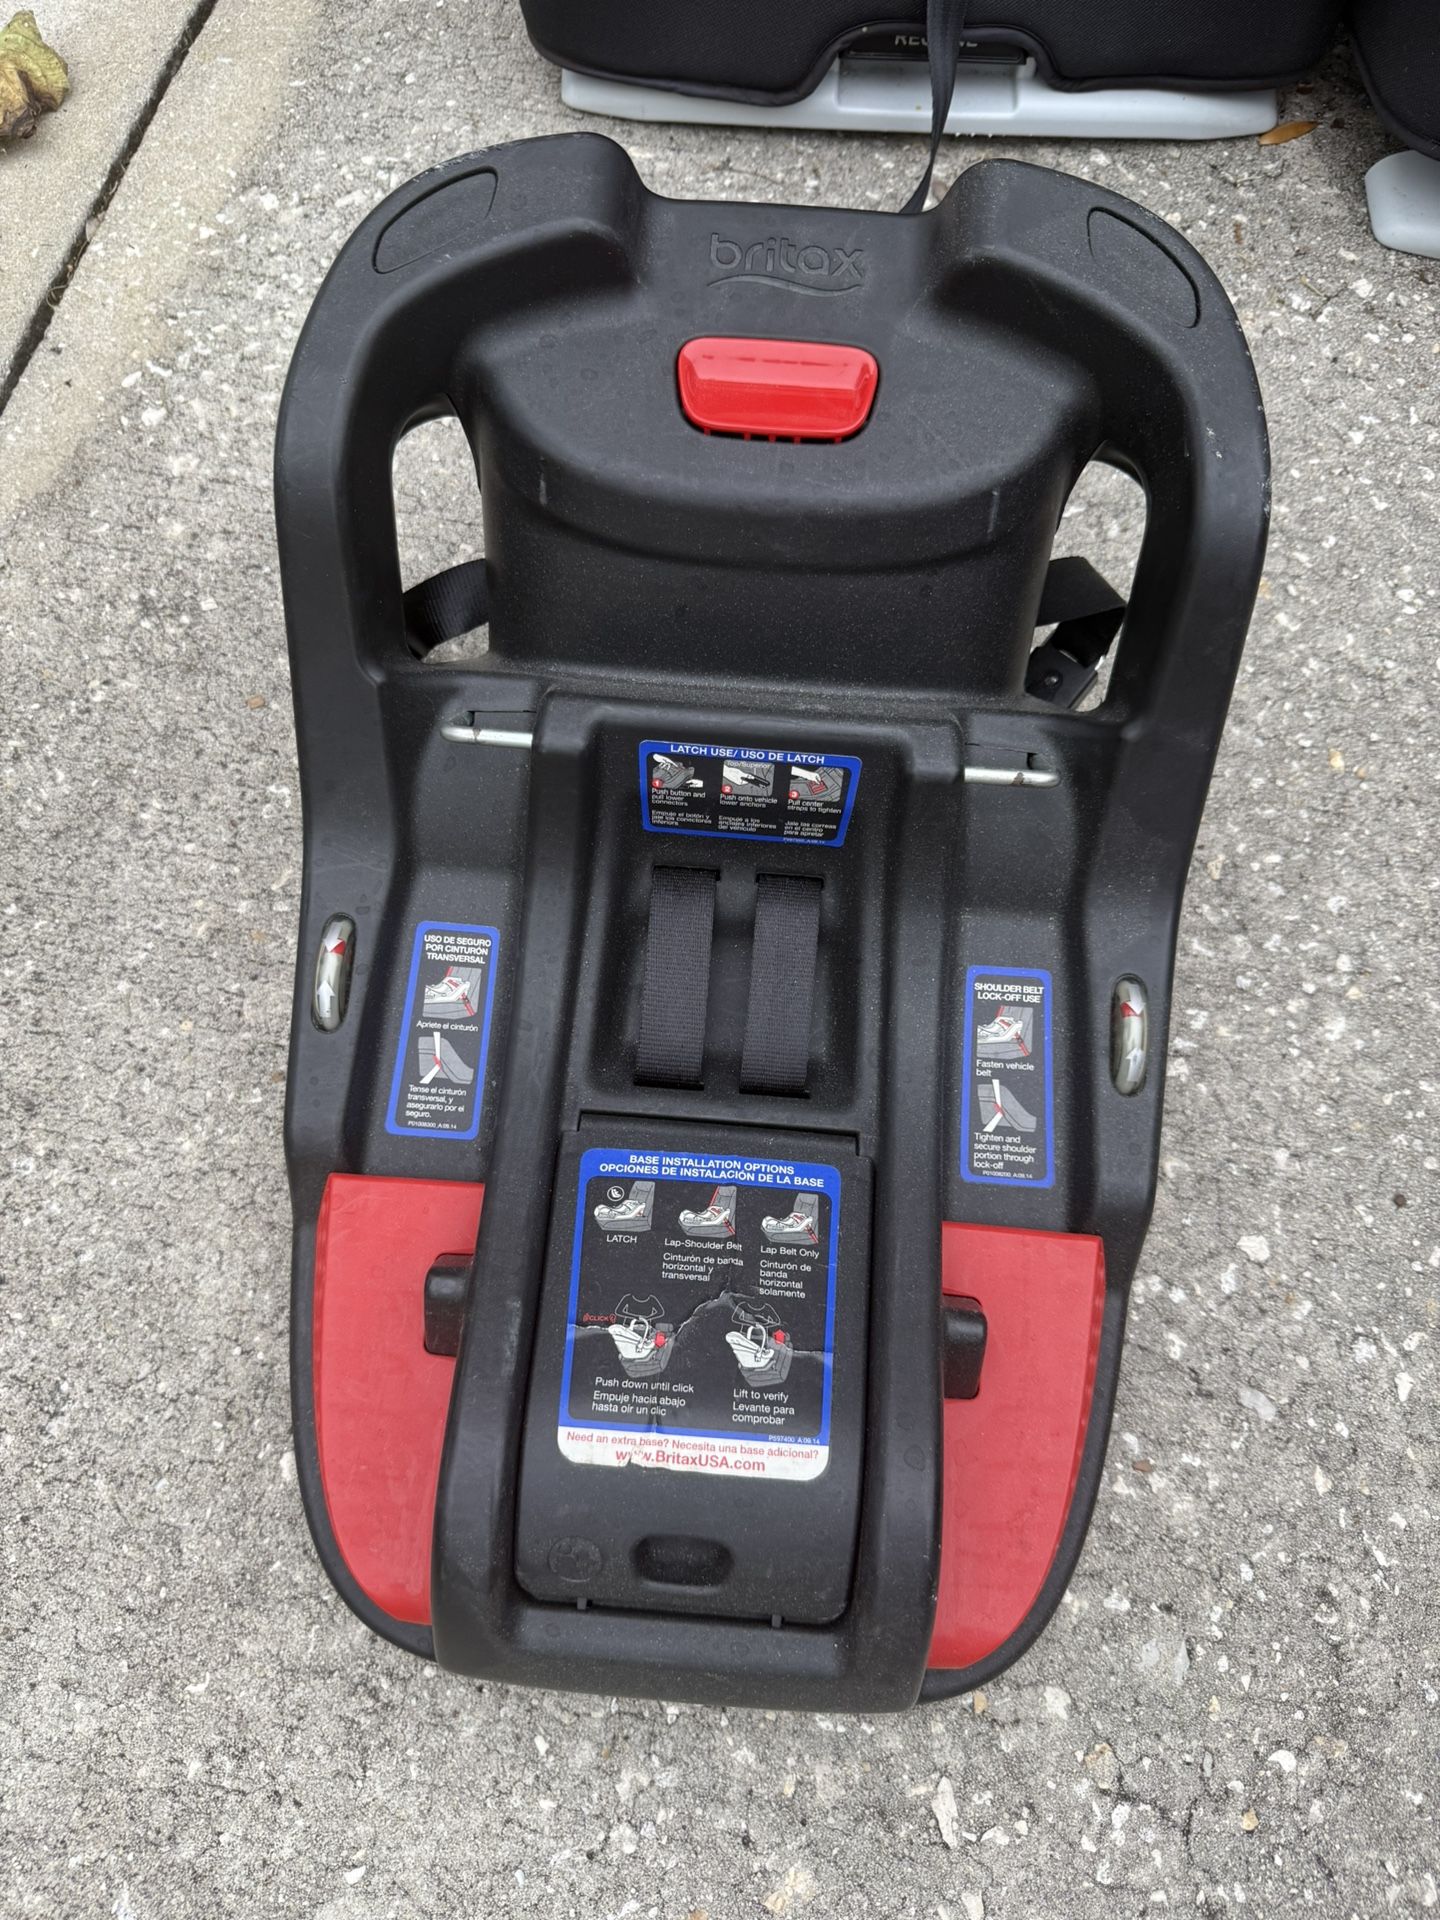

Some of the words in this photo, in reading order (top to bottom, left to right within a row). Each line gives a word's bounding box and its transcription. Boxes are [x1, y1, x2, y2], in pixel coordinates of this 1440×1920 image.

[895, 35, 978, 47] RECE
[710, 232, 864, 279] britax
[670, 744, 708, 755] LATCH
[710, 749, 738, 758] USE/
[741, 750, 765, 760] USO
[768, 752, 784, 761] DE
[787, 753, 825, 764] LATCH
[739, 800, 767, 808] anchors
[754, 796, 778, 804] vehicle
[818, 807, 842, 815] tighten
[424, 934, 442, 943] USO
[443, 936, 455, 944] DE
[456, 938, 492, 947] SEGURO
[425, 943, 444, 952] POR
[444, 945, 488, 956] CINTURÓN
[426, 952, 486, 965] TRANSVERSAL
[974, 982, 1022, 993] SHOULDER
[1023, 985, 1045, 994] BELT
[977, 992, 1022, 1002] LOCK-OFF
[1022, 994, 1041, 1004] USE
[416, 1020, 441, 1029] Apriete
[442, 1022, 449, 1030] el
[450, 1023, 479, 1032] cinturón
[976, 1059, 1004, 1069] Fasten
[1005, 1061, 1035, 1071] vehicle
[976, 1068, 992, 1077] belt
[409, 1084, 430, 1094] Tense
[430, 1086, 437, 1094] el
[438, 1087, 467, 1096] cinturón
[407, 1093, 447, 1103] transversal,
[406, 1102, 443, 1111] asegurarlo
[443, 1105, 457, 1113] por
[457, 1105, 465, 1113] el
[405, 1110, 432, 1119] seguro.
[974, 1132, 1004, 1143] Tighten
[1005, 1135, 1021, 1143] and
[974, 1143, 1001, 1152] secure
[1002, 1144, 1037, 1154] shoulder
[629, 1154, 660, 1165] BASE
[662, 1157, 741, 1170] INSTALLATION
[743, 1162, 795, 1175] OPTIONS
[973, 1152, 1002, 1161] portion
[1003, 1153, 1034, 1165] through
[973, 1159, 1004, 1169] lock-off
[599, 1163, 659, 1175] OPCIONES
[661, 1166, 678, 1176] DE
[680, 1168, 755, 1181] INSTALACIÓN
[758, 1174, 774, 1183] DE
[776, 1175, 792, 1185] LA
[794, 1177, 825, 1188] BASE
[606, 1234, 638, 1244] LATCH
[664, 1237, 724, 1250] Lap-Shoulder
[726, 1241, 743, 1251] Belt
[760, 1245, 778, 1256] Lap
[779, 1246, 797, 1256] Belt
[799, 1247, 820, 1259] Only
[663, 1252, 701, 1263] Cinturón
[702, 1255, 715, 1264] de
[716, 1256, 744, 1267] banda
[760, 1259, 798, 1271] Cinturón
[799, 1263, 812, 1273] de
[662, 1262, 706, 1273] horizontal
[707, 1266, 714, 1275] y
[759, 1269, 788, 1279] banda
[661, 1270, 711, 1282] transversal
[759, 1277, 804, 1289] horizontal
[759, 1287, 806, 1300] solamente
[594, 1376, 619, 1388] Push
[621, 1378, 649, 1390] down
[650, 1381, 670, 1392] until
[672, 1383, 695, 1393] click
[593, 1390, 630, 1404] Empuje
[631, 1393, 658, 1404] hacia
[659, 1396, 687, 1408] abajo
[733, 1388, 749, 1399] Lift
[750, 1390, 761, 1400] to
[763, 1391, 789, 1404] verify
[591, 1402, 619, 1413] hasta
[635, 1406, 648, 1415] un
[650, 1405, 667, 1416] clic
[732, 1401, 771, 1414] Levante
[773, 1405, 795, 1416] para
[731, 1413, 786, 1426] comprobar
[566, 1431, 594, 1442] Need
[596, 1434, 609, 1443] an
[611, 1435, 637, 1446] extra
[639, 1436, 670, 1447] base?
[671, 1440, 716, 1452] Necesita
[718, 1446, 738, 1454] una
[740, 1443, 765, 1456] base
[767, 1446, 819, 1459] adicional?
